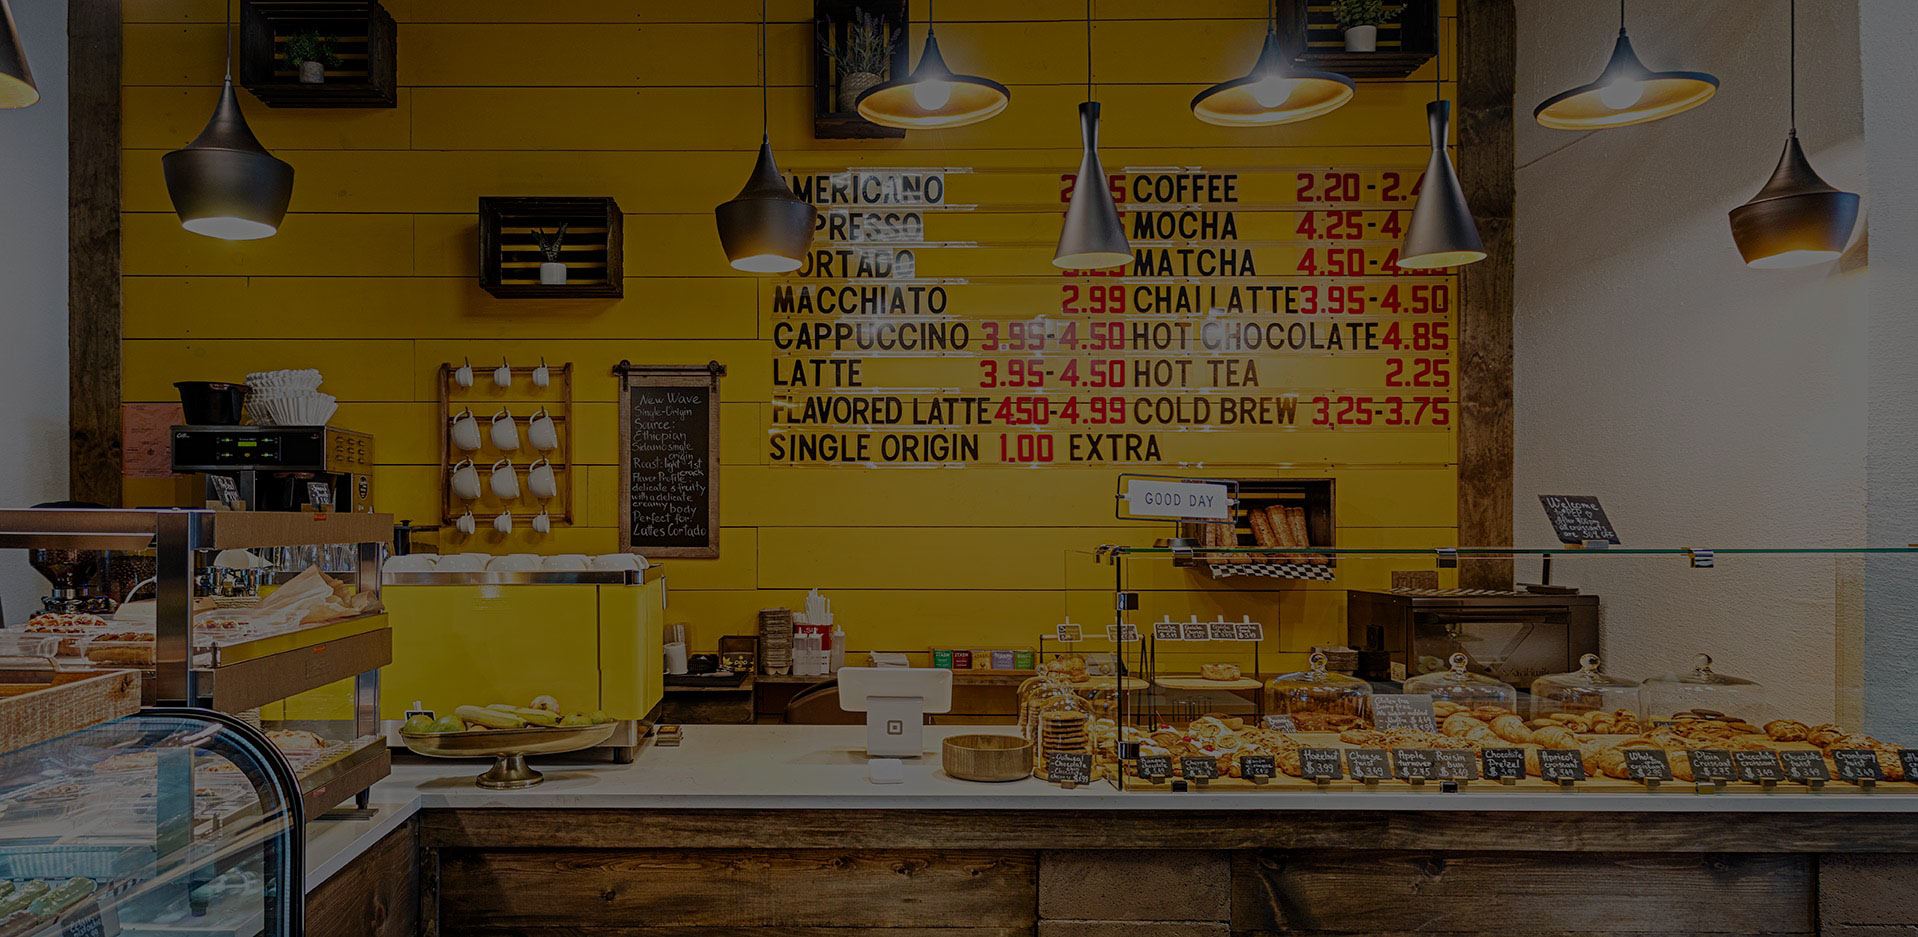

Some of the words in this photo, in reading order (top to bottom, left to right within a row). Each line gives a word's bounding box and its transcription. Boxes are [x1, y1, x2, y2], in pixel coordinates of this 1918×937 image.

[782, 175, 943, 204] MERICANO
[1133, 175, 1238, 202] COFFEE
[816, 212, 922, 241] PRESSO
[1133, 211, 1238, 240] MOCHA
[797, 249, 915, 278] ORTADO
[1133, 248, 1256, 276] MATCHA
[773, 286, 947, 314] MACCHIATO
[1062, 285, 1126, 314] 2.99
[1134, 286, 1200, 313] CHAI
[1211, 286, 1299, 314] LATTE
[774, 322, 970, 351] CAPPUCCINO
[981, 321, 1125, 350] 3.95-4.50
[1133, 322, 1192, 350] HOT
[1201, 322, 1379, 350] CHOCOLATE
[1381, 321, 1449, 351] 4.85
[773, 358, 863, 387] LATTE
[980, 359, 1125, 388] 3.95-4.50
[1133, 359, 1193, 387] HOT
[1208, 359, 1260, 387] TEA
[1385, 358, 1450, 387] 2.25
[640, 394, 664, 405] New
[667, 392, 702, 405] Wave
[772, 396, 903, 425] FLAVORED
[913, 397, 992, 425] LATTE
[1134, 396, 1211, 425] COLD
[1220, 396, 1298, 424] BREW
[633, 430, 687, 443] Ethiopian
[769, 434, 871, 462] SINGLE
[881, 433, 979, 461] ORIGIN
[999, 434, 1054, 462] 1.00
[1069, 434, 1162, 462] EXTRA
[669, 452, 694, 465] origin
[687, 457, 703, 470] 1st
[680, 469, 704, 477] crack
[632, 482, 668, 492] delicate
[656, 491, 694, 502] delicate
[1145, 492, 1182, 506] GOOD
[1189, 494, 1214, 507] DAY
[1545, 497, 1600, 511] Welcome
[632, 501, 668, 511] creamy
[669, 503, 697, 518] body
[632, 510, 671, 524] Perfect
[633, 523, 666, 537] Lattes
[667, 523, 707, 537] Cortado
[1349, 751, 1383, 761] Cheese
[1398, 750, 1426, 760] Apple
[1435, 750, 1466, 761] Raisin
[1695, 751, 1720, 761] Plain
[1487, 759, 1520, 768] Pretzel
